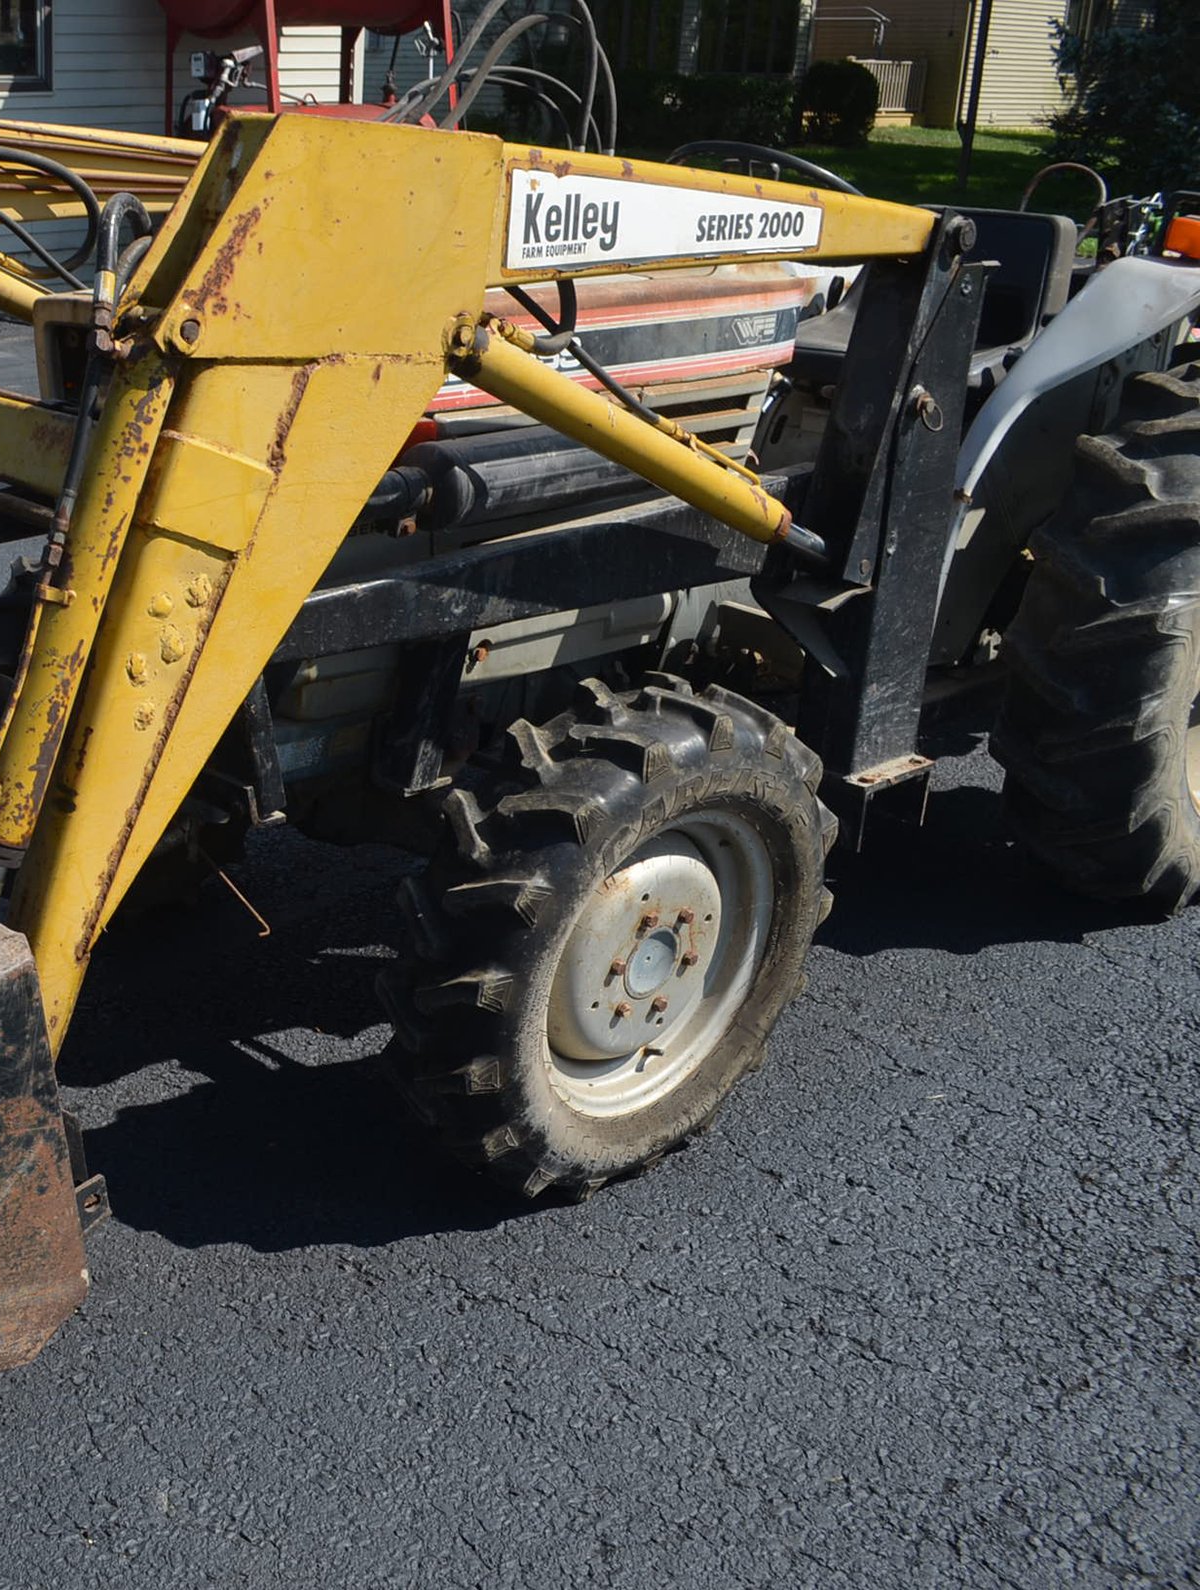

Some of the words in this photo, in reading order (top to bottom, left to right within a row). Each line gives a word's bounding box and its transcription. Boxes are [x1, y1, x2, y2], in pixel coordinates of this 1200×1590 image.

[523, 193, 620, 251] Kelley
[695, 213, 754, 243] SERIES
[758, 211, 805, 239] 2000
[522, 245, 543, 259] FARM
[545, 243, 587, 257] EQUIPMENT
